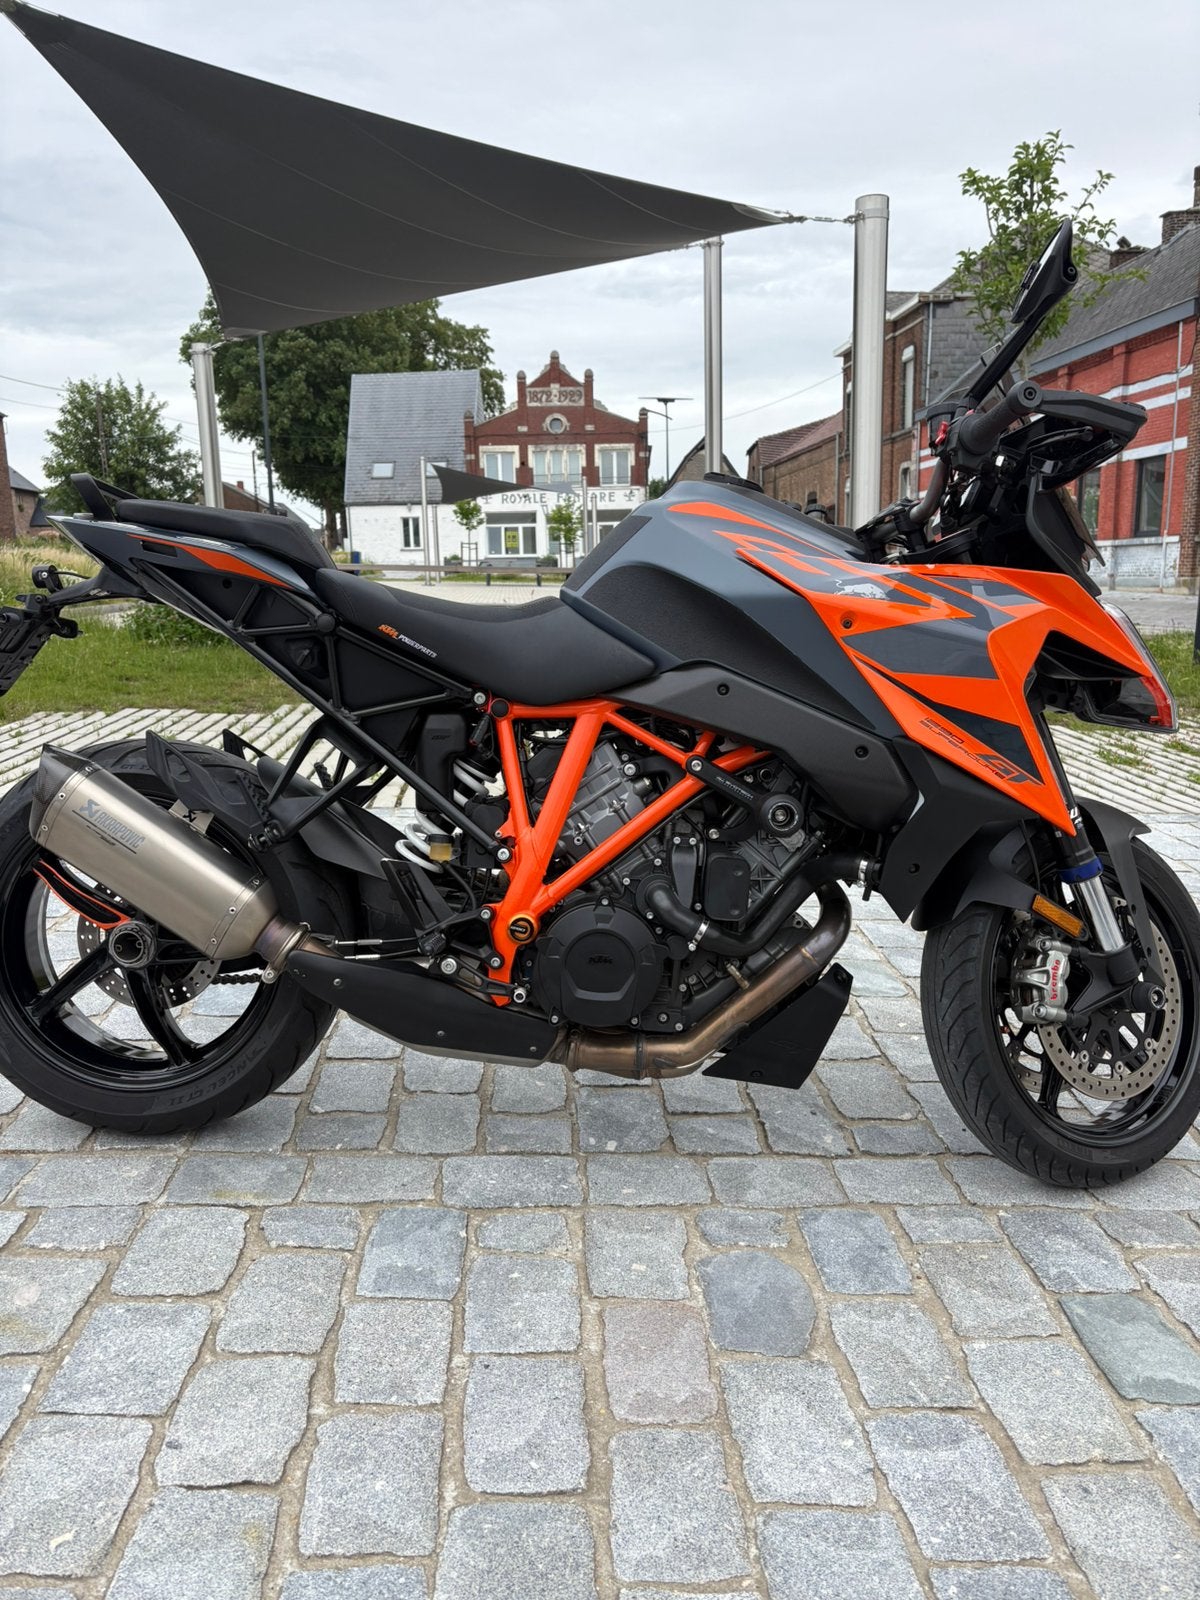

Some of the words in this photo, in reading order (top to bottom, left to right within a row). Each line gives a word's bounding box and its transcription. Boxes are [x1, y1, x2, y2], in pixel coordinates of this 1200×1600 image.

[501, 493, 547, 504] ROYALE
[398, 634, 438, 659] POWERPARTS
[976, 752, 1043, 786] GT
[1050, 959, 1061, 1001] brembo
